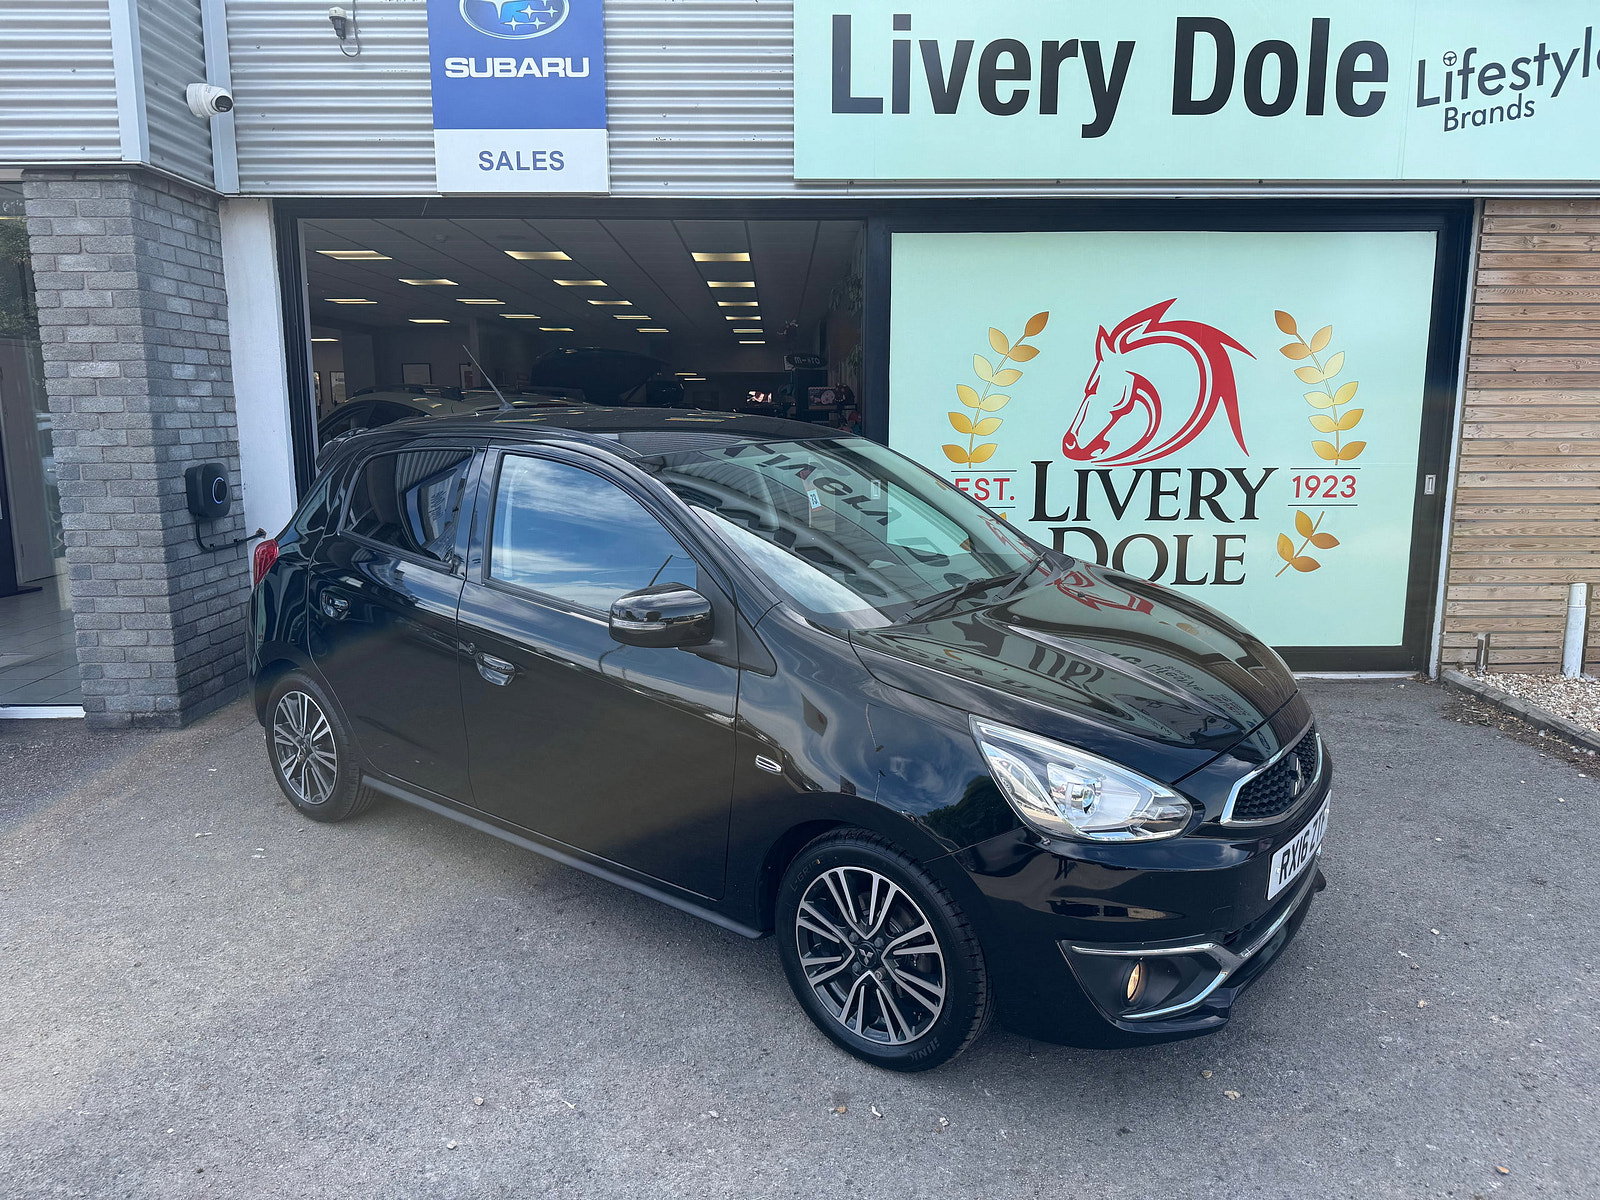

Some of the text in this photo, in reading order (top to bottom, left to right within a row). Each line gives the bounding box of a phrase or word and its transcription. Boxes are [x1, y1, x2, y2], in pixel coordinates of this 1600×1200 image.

[445, 57, 590, 78] SUBARU
[831, 14, 1389, 139] Livery Dole
[1416, 27, 1600, 108] Lifestyl
[1444, 93, 1535, 132] Brands
[478, 150, 565, 172] SALES
[1028, 460, 1279, 524] LIVERY
[1292, 475, 1357, 499] 1923
[1048, 527, 1247, 586] DOLE
[1278, 828, 1310, 885] RX16
